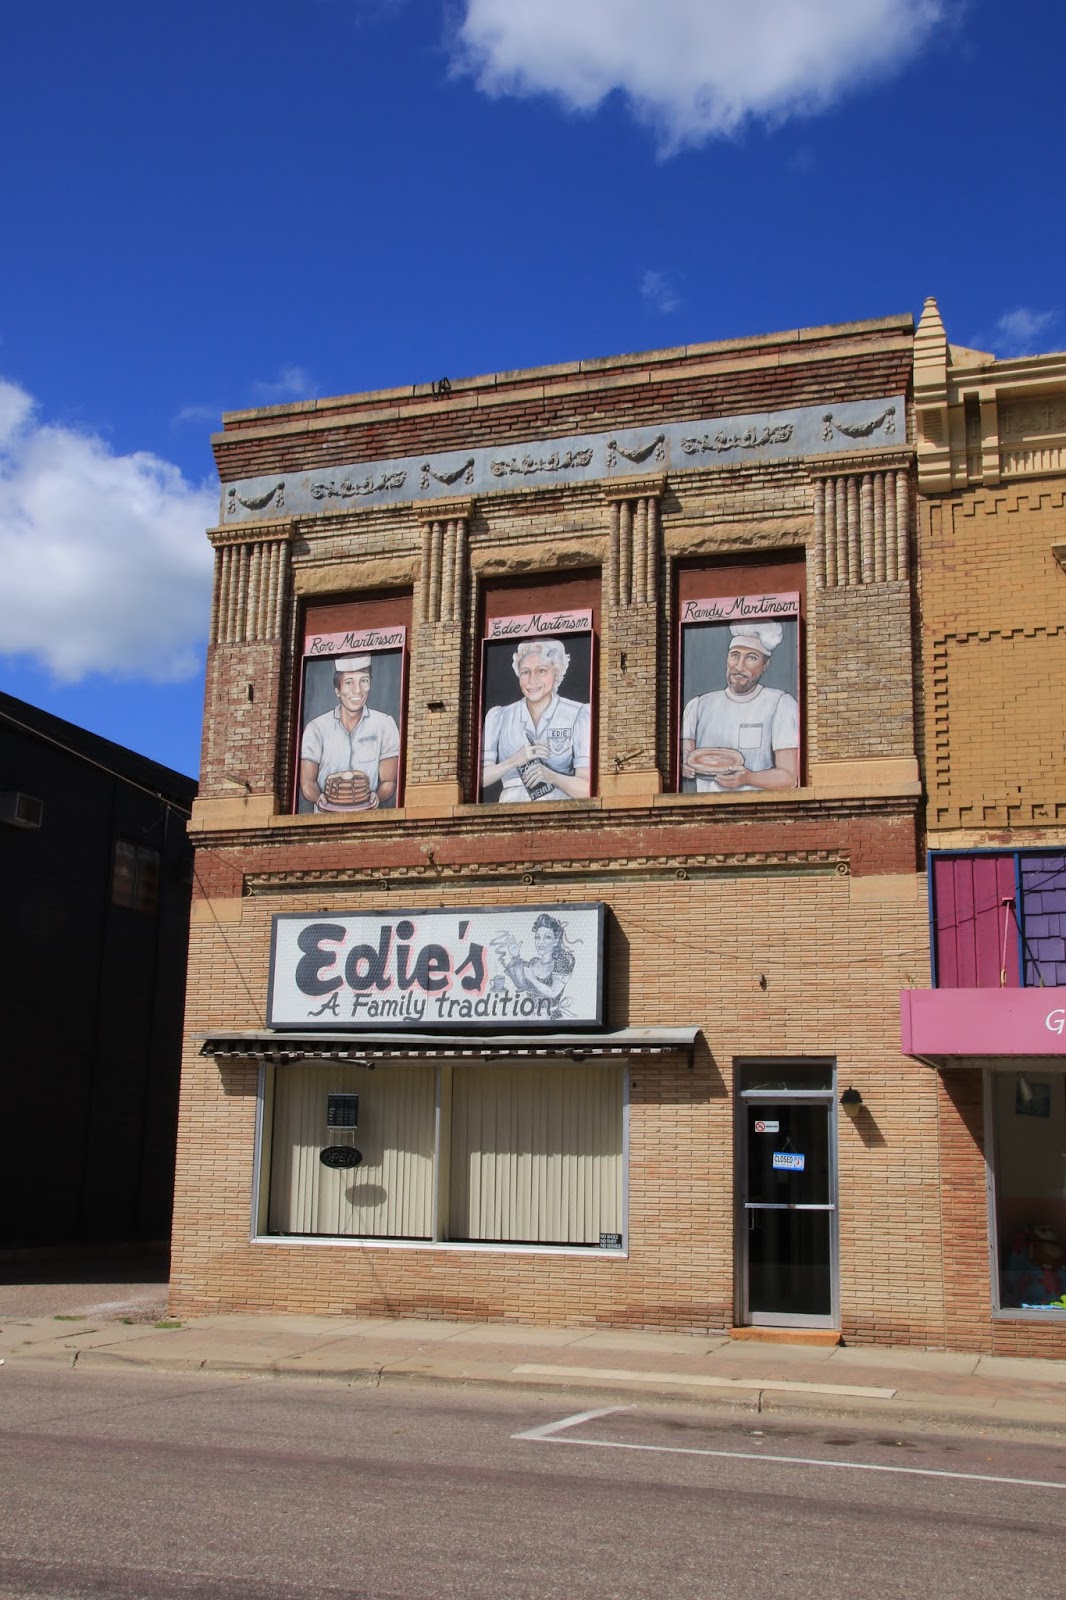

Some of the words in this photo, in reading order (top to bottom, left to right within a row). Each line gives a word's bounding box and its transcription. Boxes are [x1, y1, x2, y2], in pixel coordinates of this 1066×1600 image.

[684, 601, 730, 620] Randy
[726, 596, 798, 616] Martinson
[490, 620, 526, 638] Edie
[524, 614, 588, 632] Martinson
[310, 637, 334, 654] Ron
[338, 632, 403, 650] Martinson
[530, 784, 553, 800] MENU
[295, 920, 486, 998] Edie's
[308, 992, 340, 1017] A
[351, 990, 427, 1021] Family
[435, 990, 552, 1018] tradition
[324, 1153, 357, 1163] OPEN
[774, 1155, 793, 1164] CLOSED
